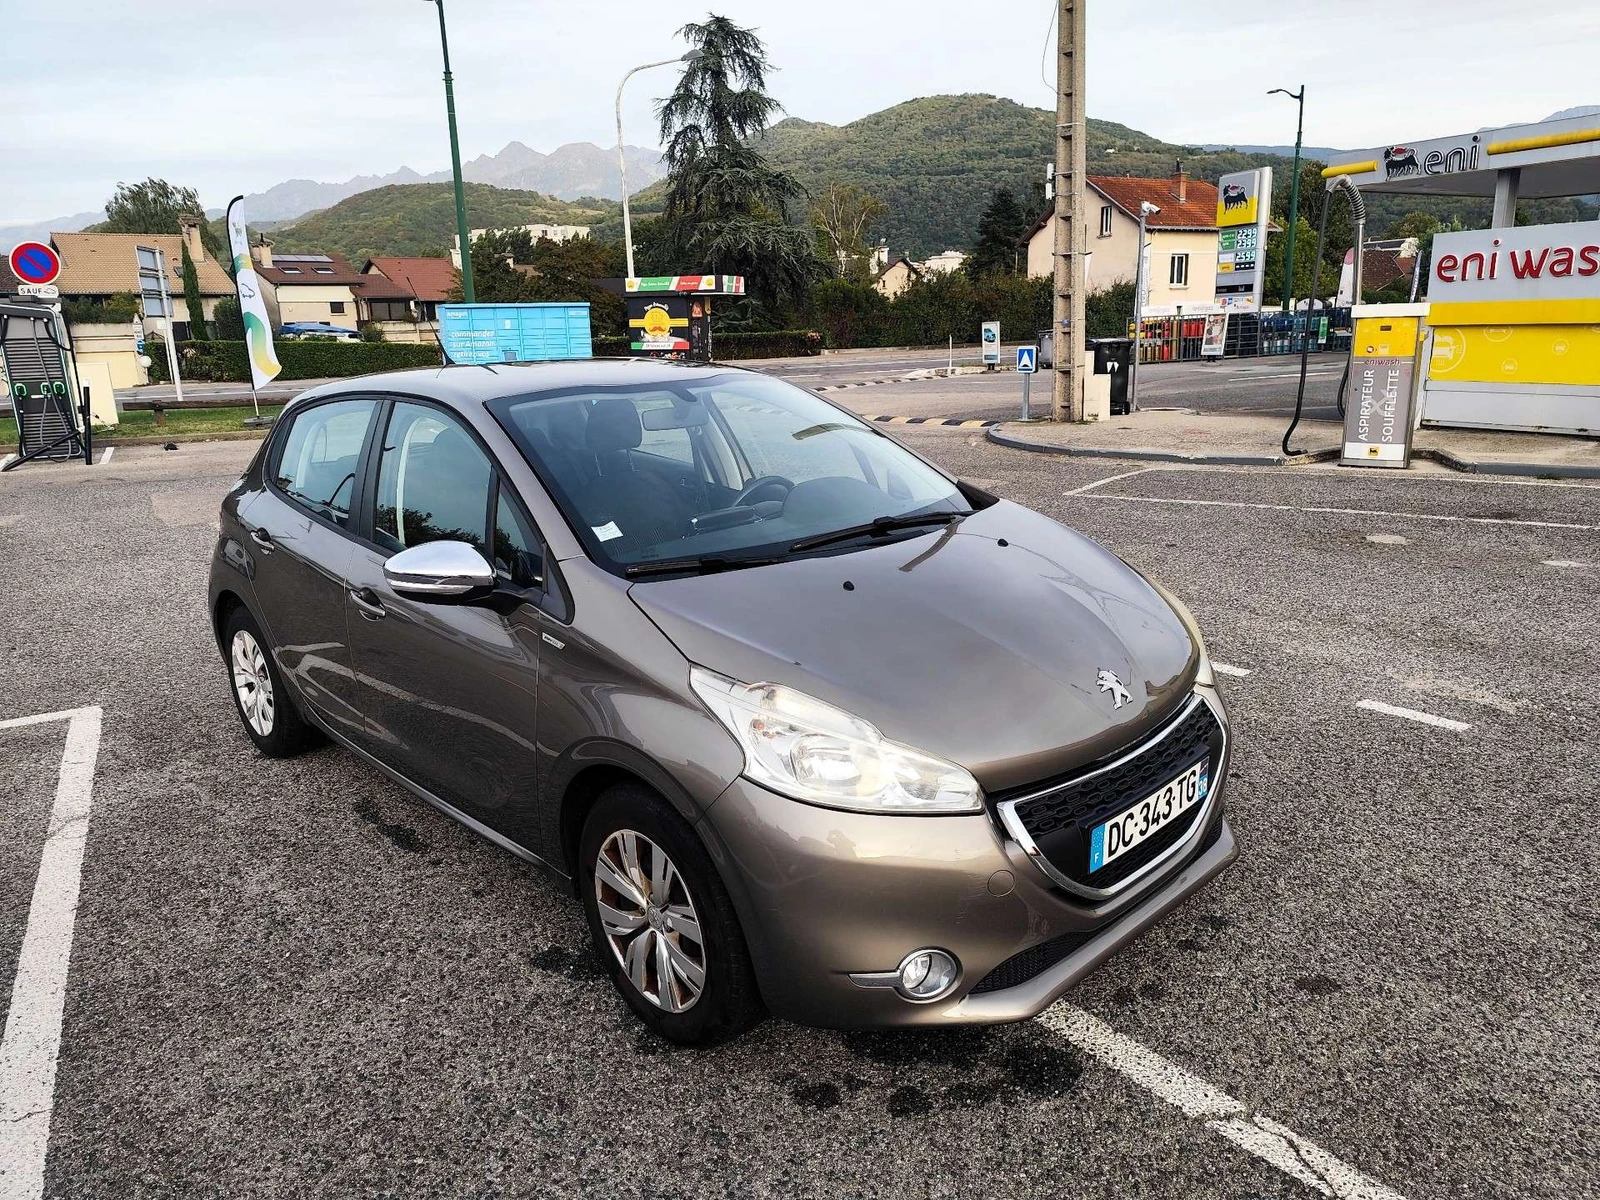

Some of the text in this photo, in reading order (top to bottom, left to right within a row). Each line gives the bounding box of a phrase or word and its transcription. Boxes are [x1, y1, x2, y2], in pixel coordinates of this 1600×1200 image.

[1423, 135, 1480, 175] eni
[1436, 239, 1501, 283] eni
[20, 287, 42, 295] SAUF
[452, 330, 494, 338] commandez
[1358, 369, 1375, 442] ASPIRATEUR
[1382, 369, 1400, 443] SOUFFLETTE
[1094, 852, 1100, 864] F
